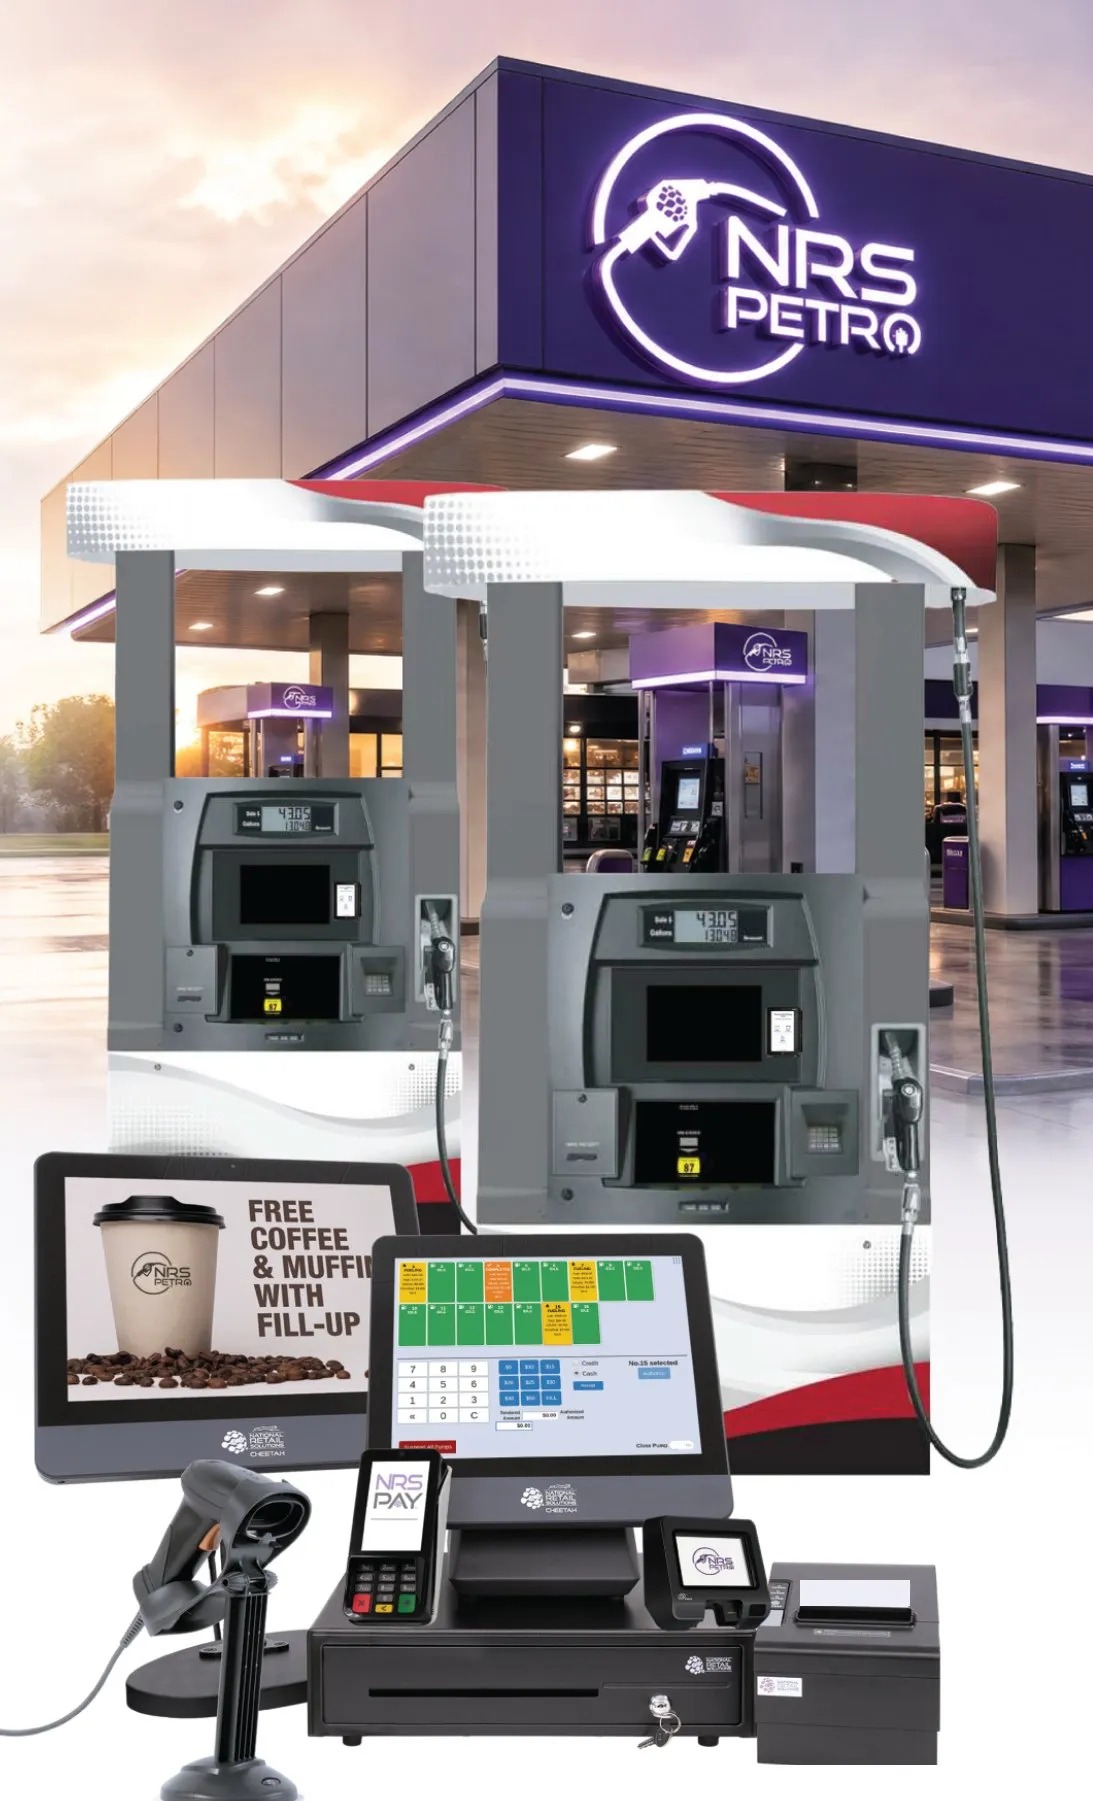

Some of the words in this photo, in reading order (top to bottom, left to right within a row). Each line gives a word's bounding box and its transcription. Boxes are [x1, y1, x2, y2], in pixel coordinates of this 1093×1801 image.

[728, 215, 917, 306] NRS
[728, 286, 921, 355] PETRO
[762, 648, 791, 659] NRS
[654, 916, 667, 924] Sale
[649, 929, 672, 937] Gallons
[683, 1163, 695, 1173] 87
[248, 1199, 314, 1223] FREE
[251, 1226, 349, 1251] COFFEE
[154, 1267, 191, 1278] NRS
[253, 1255, 274, 1279] &
[154, 1278, 192, 1286] PETRO
[254, 1284, 324, 1307] WITH
[257, 1312, 360, 1337] FILL-UP
[410, 1365, 416, 1373] 7
[440, 1365, 447, 1373] 8
[471, 1364, 477, 1373] 9
[409, 1381, 416, 1389] 4
[440, 1380, 447, 1389] 5
[471, 1380, 477, 1388] 6
[410, 1396, 416, 1405] 1
[440, 1396, 447, 1405] 2
[471, 1396, 478, 1404] 3
[440, 1411, 447, 1420] 0
[470, 1411, 479, 1420] C
[375, 1473, 423, 1491] NRS
[373, 1492, 423, 1510] PAY
[708, 1556, 734, 1566] NRS
